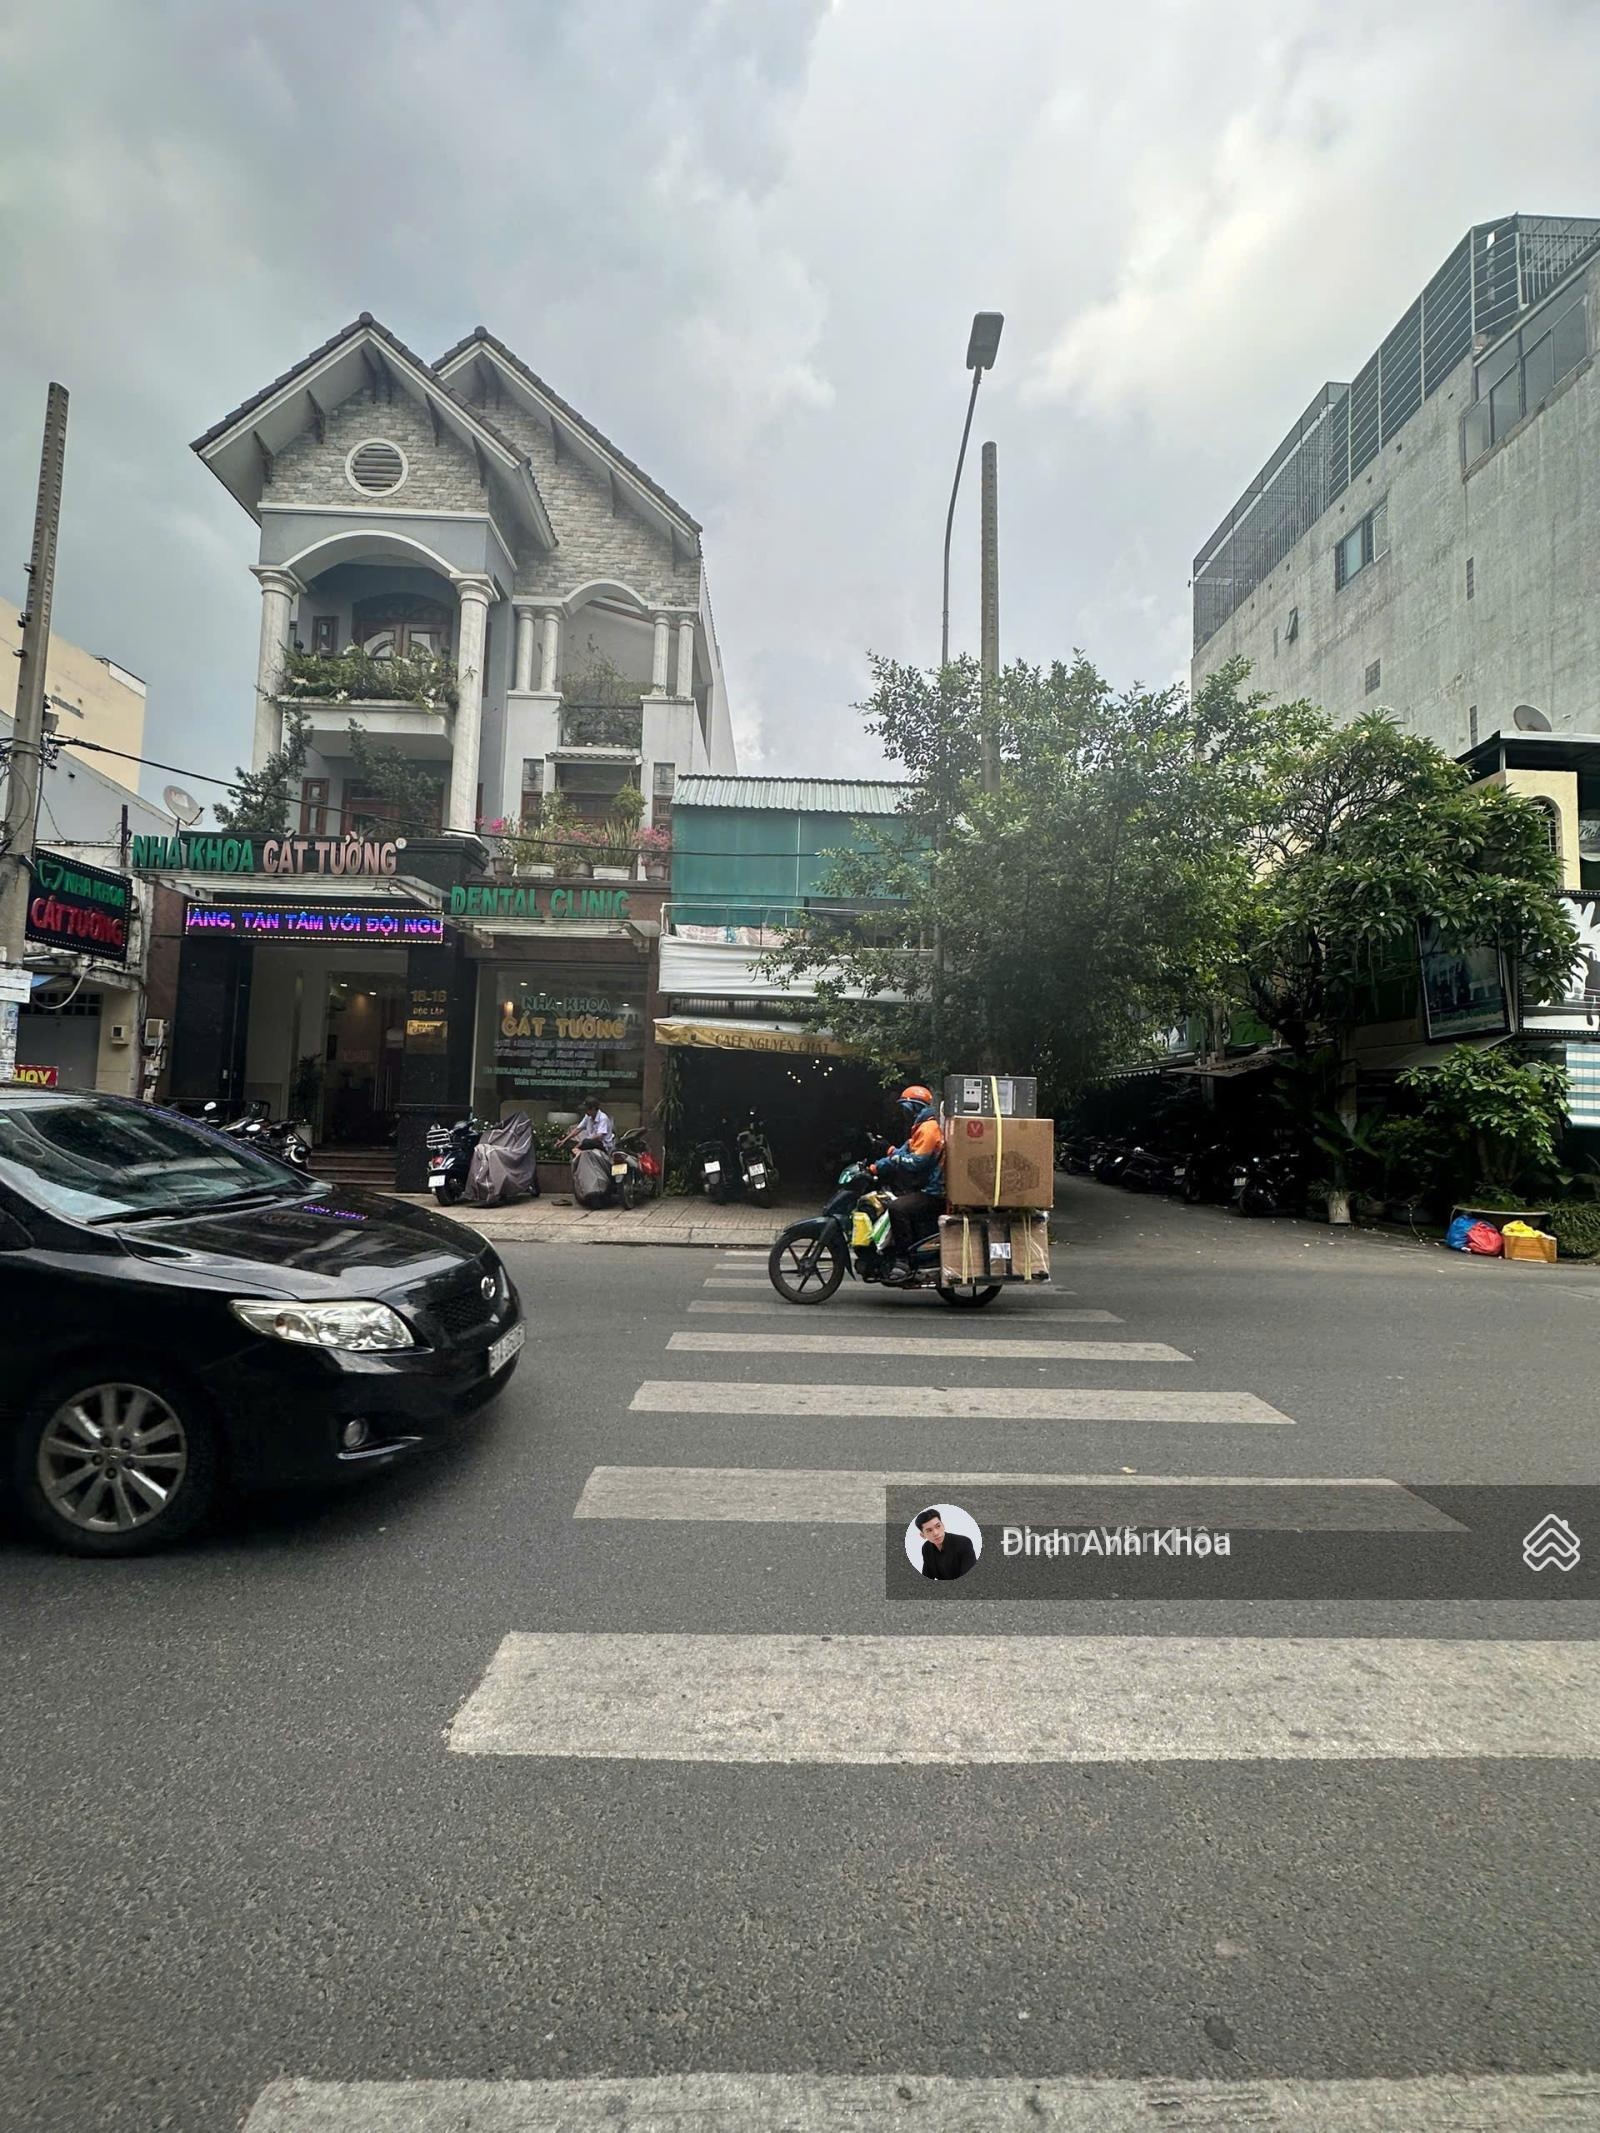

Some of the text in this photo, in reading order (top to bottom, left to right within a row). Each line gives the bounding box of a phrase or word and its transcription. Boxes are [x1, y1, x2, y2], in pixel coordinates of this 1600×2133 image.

[132, 834, 184, 869] NHA
[186, 836, 254, 872] KHOA
[262, 829, 308, 874] CÁT
[314, 830, 397, 875] TƯỜNG
[450, 885, 631, 919] DENTAL CLINIC
[284, 910, 324, 932] TÂM
[328, 912, 361, 932] VỚI
[365, 915, 399, 936] ĐỘI
[524, 995, 612, 1013] NHA KHOA
[501, 1011, 626, 1039] CÁT TƯỜNG
